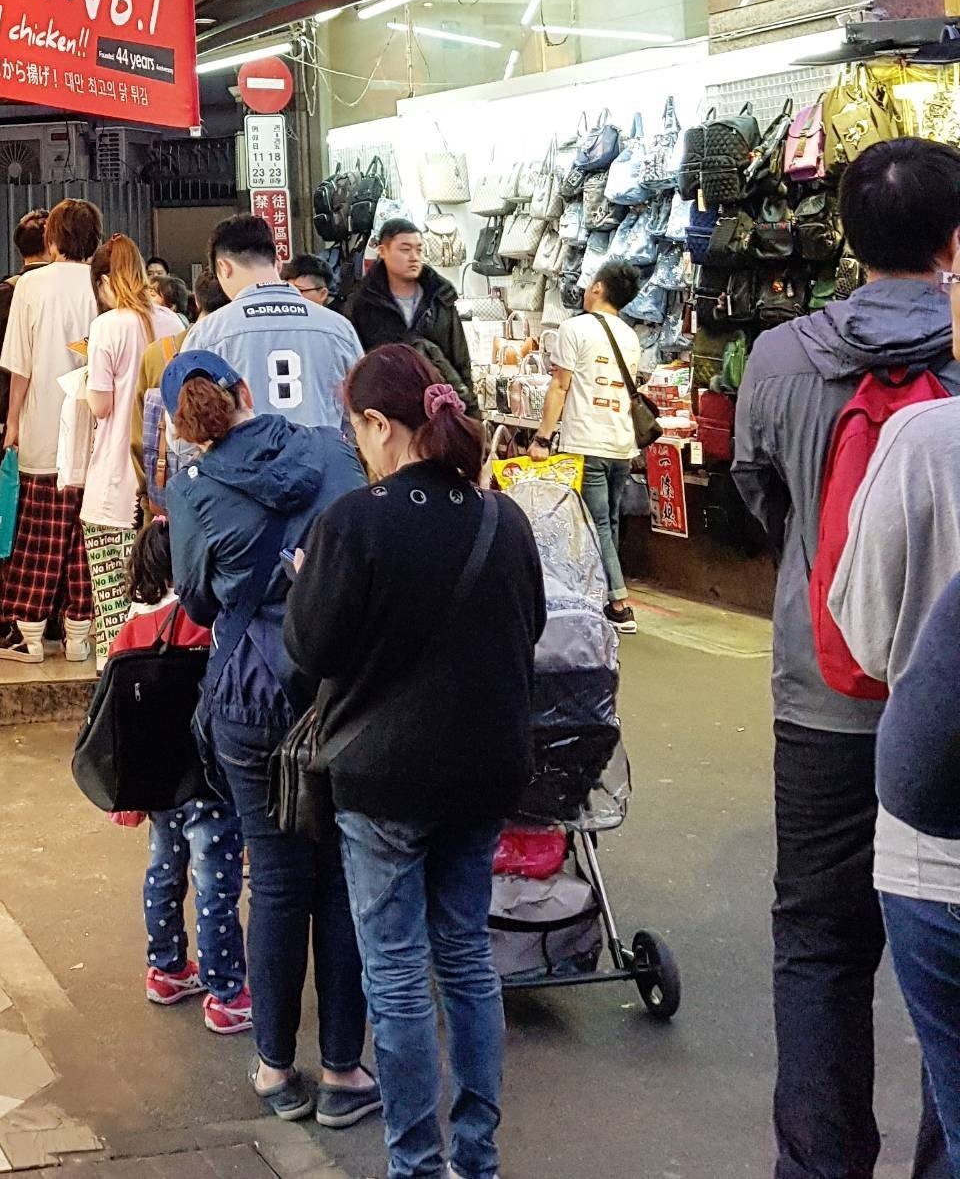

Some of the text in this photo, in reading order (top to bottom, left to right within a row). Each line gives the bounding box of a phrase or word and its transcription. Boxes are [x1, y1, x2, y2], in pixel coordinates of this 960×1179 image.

[8, 13, 90, 58] chicken!!
[115, 46, 129, 65] 44
[130, 52, 155, 72] years
[64, 71, 149, 106] 대만 최고의 닭 튀김
[253, 152, 264, 161] 11
[268, 152, 281, 161] 18
[252, 168, 265, 177] 23
[269, 168, 282, 177] 23
[271, 194, 288, 256] 徒步區內
[246, 305, 306, 315] G-DRAGON
[267, 349, 303, 409] 8
